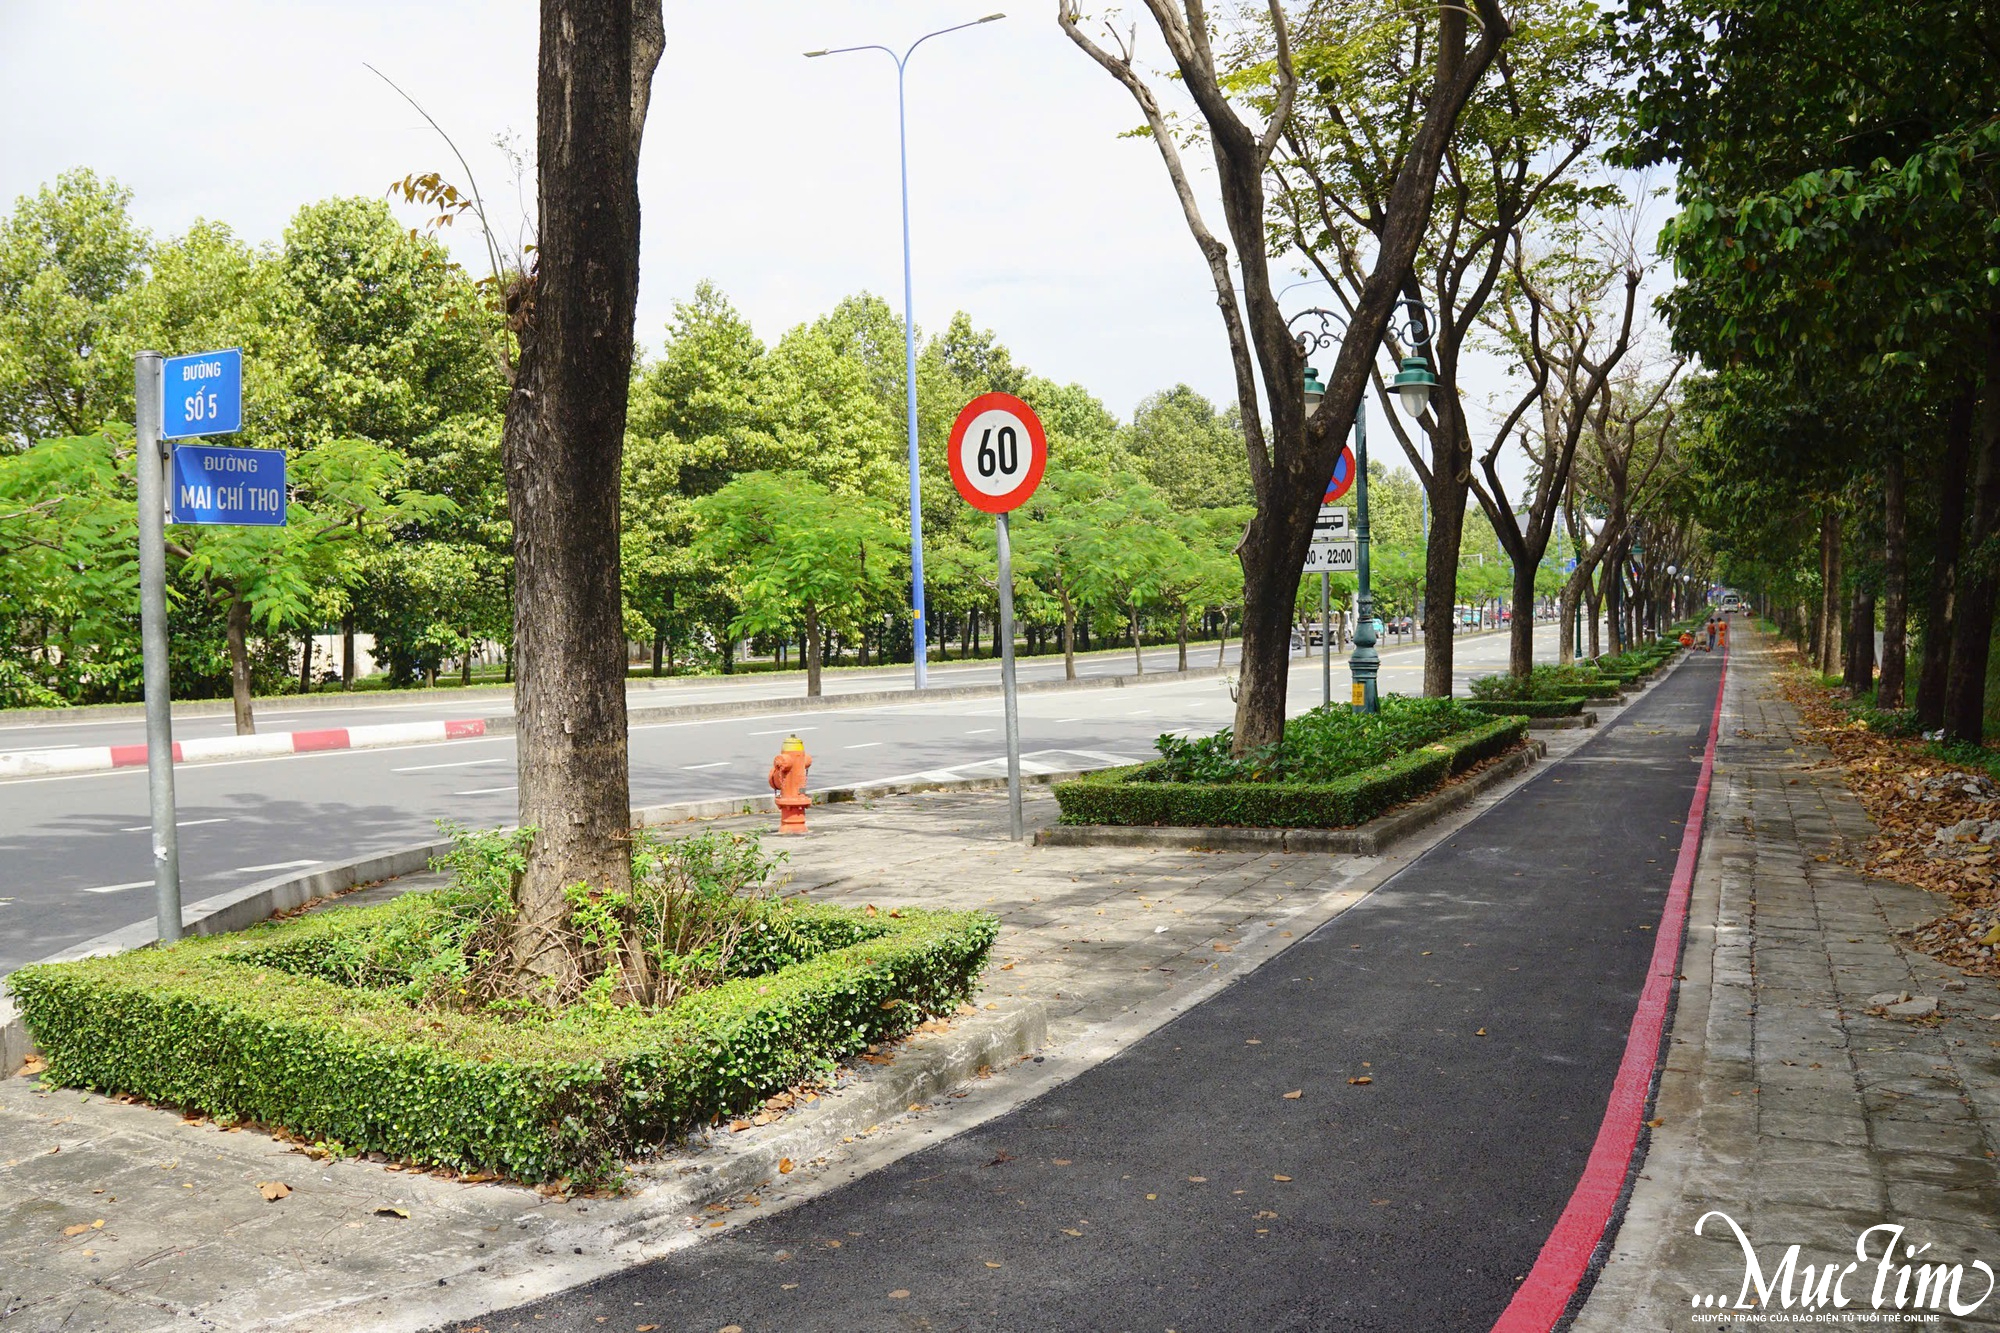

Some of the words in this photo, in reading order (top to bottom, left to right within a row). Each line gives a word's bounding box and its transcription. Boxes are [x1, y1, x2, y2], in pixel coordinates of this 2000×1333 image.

[183, 361, 221, 381] ĐƯỜNG
[185, 386, 206, 421] SỐ
[208, 394, 217, 419] 5
[204, 454, 258, 473] ĐƯỜNG
[977, 426, 1018, 477] 60
[181, 485, 211, 509] MAI
[217, 481, 245, 510] CHÍ
[248, 487, 279, 516] THỌ
[1327, 549, 1352, 563] 22:00
